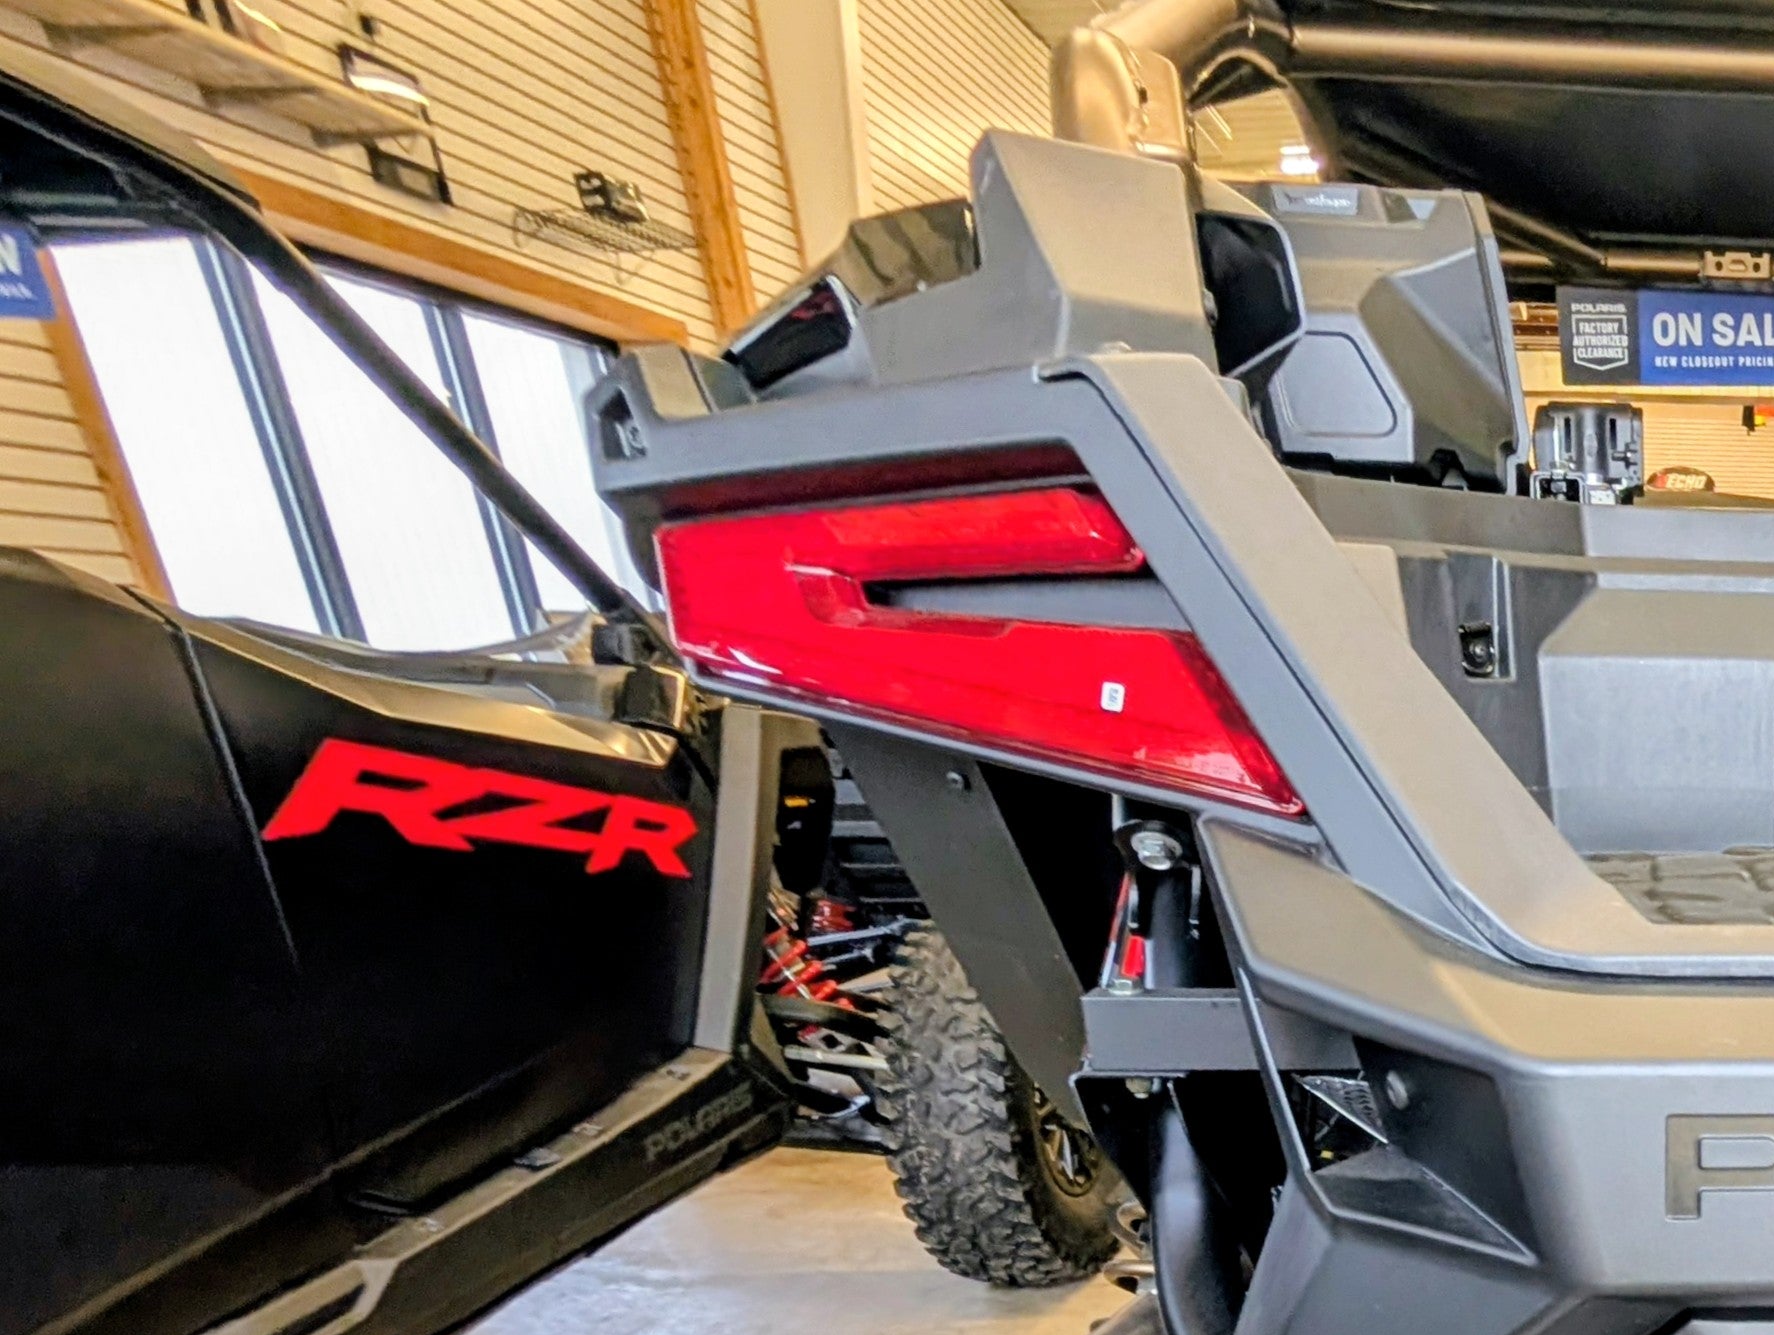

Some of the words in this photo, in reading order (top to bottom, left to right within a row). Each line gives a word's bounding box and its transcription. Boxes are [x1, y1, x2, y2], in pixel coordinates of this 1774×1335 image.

[1571, 303, 1627, 313] POLARIS
[1579, 321, 1619, 333] FACTORY
[1652, 311, 1703, 347] ON
[1573, 334, 1629, 347] AUTHORIZED
[1577, 346, 1624, 359] CLEARANCE
[1654, 355, 1678, 368] NEW
[1681, 355, 1734, 368] CLOSEOUT
[1665, 472, 1708, 490] ECHO
[260, 737, 698, 879] RZR
